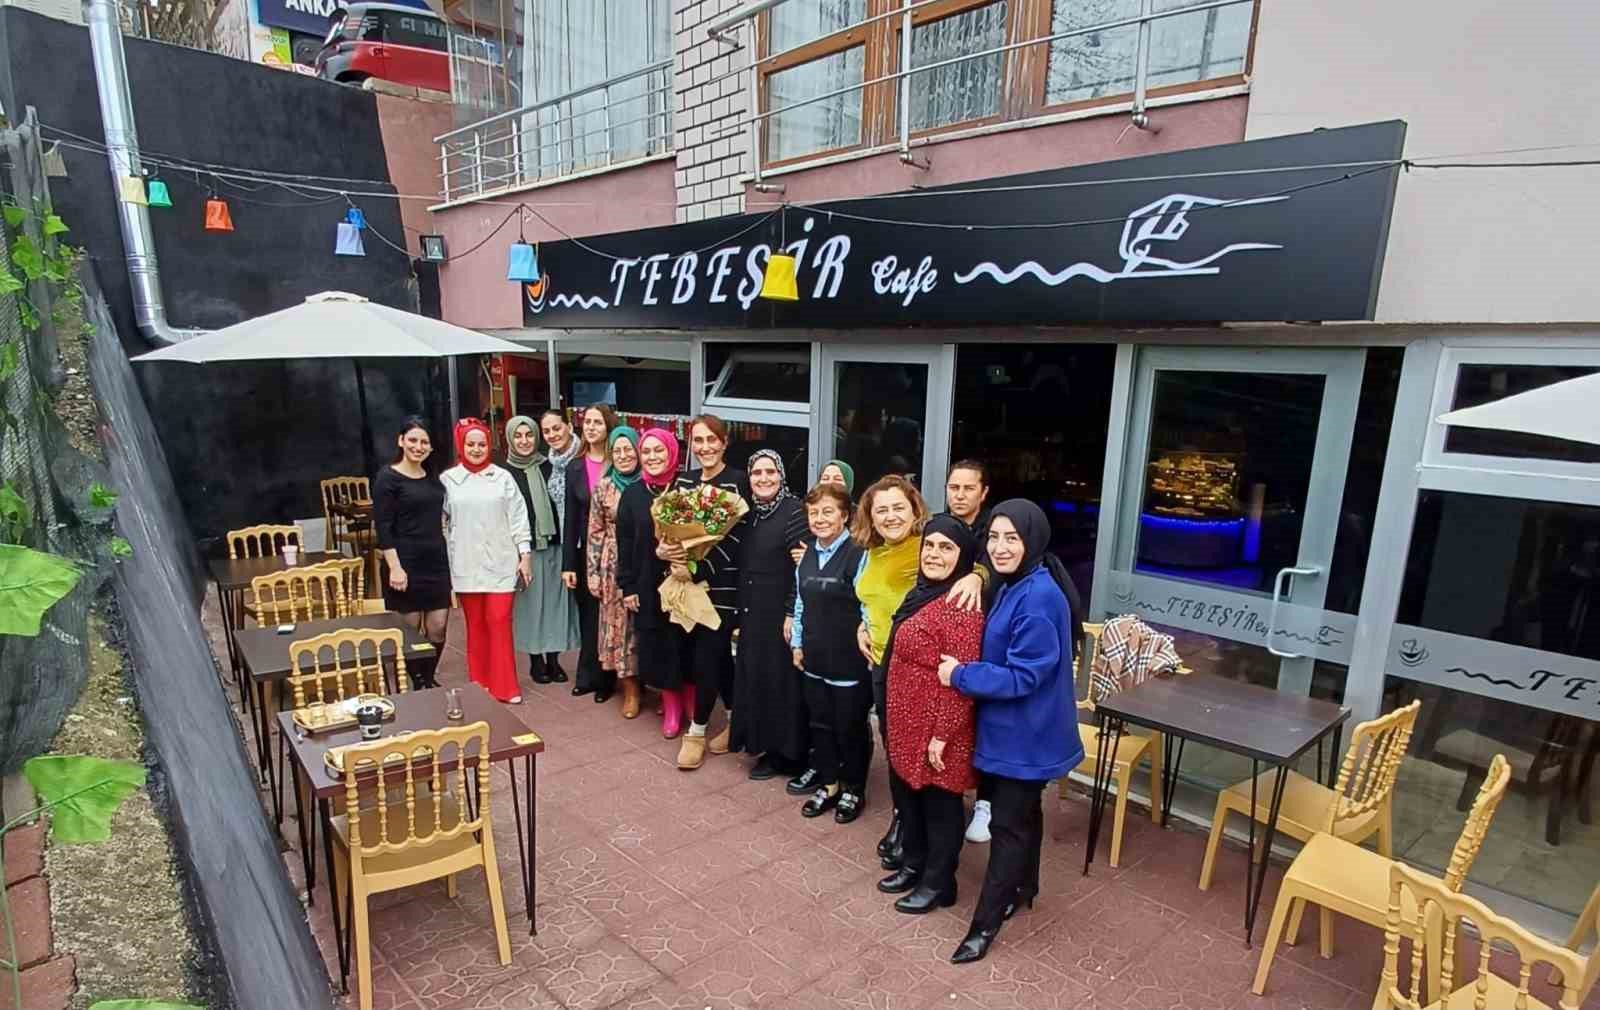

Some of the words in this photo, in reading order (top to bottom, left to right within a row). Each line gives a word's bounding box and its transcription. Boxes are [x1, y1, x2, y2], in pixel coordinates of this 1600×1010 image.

[610, 217, 851, 309] TEBEŞİR
[871, 255, 937, 306] Cafe
[1167, 596, 1258, 631] TEBEŞİR
[1529, 670, 1600, 705] TE
